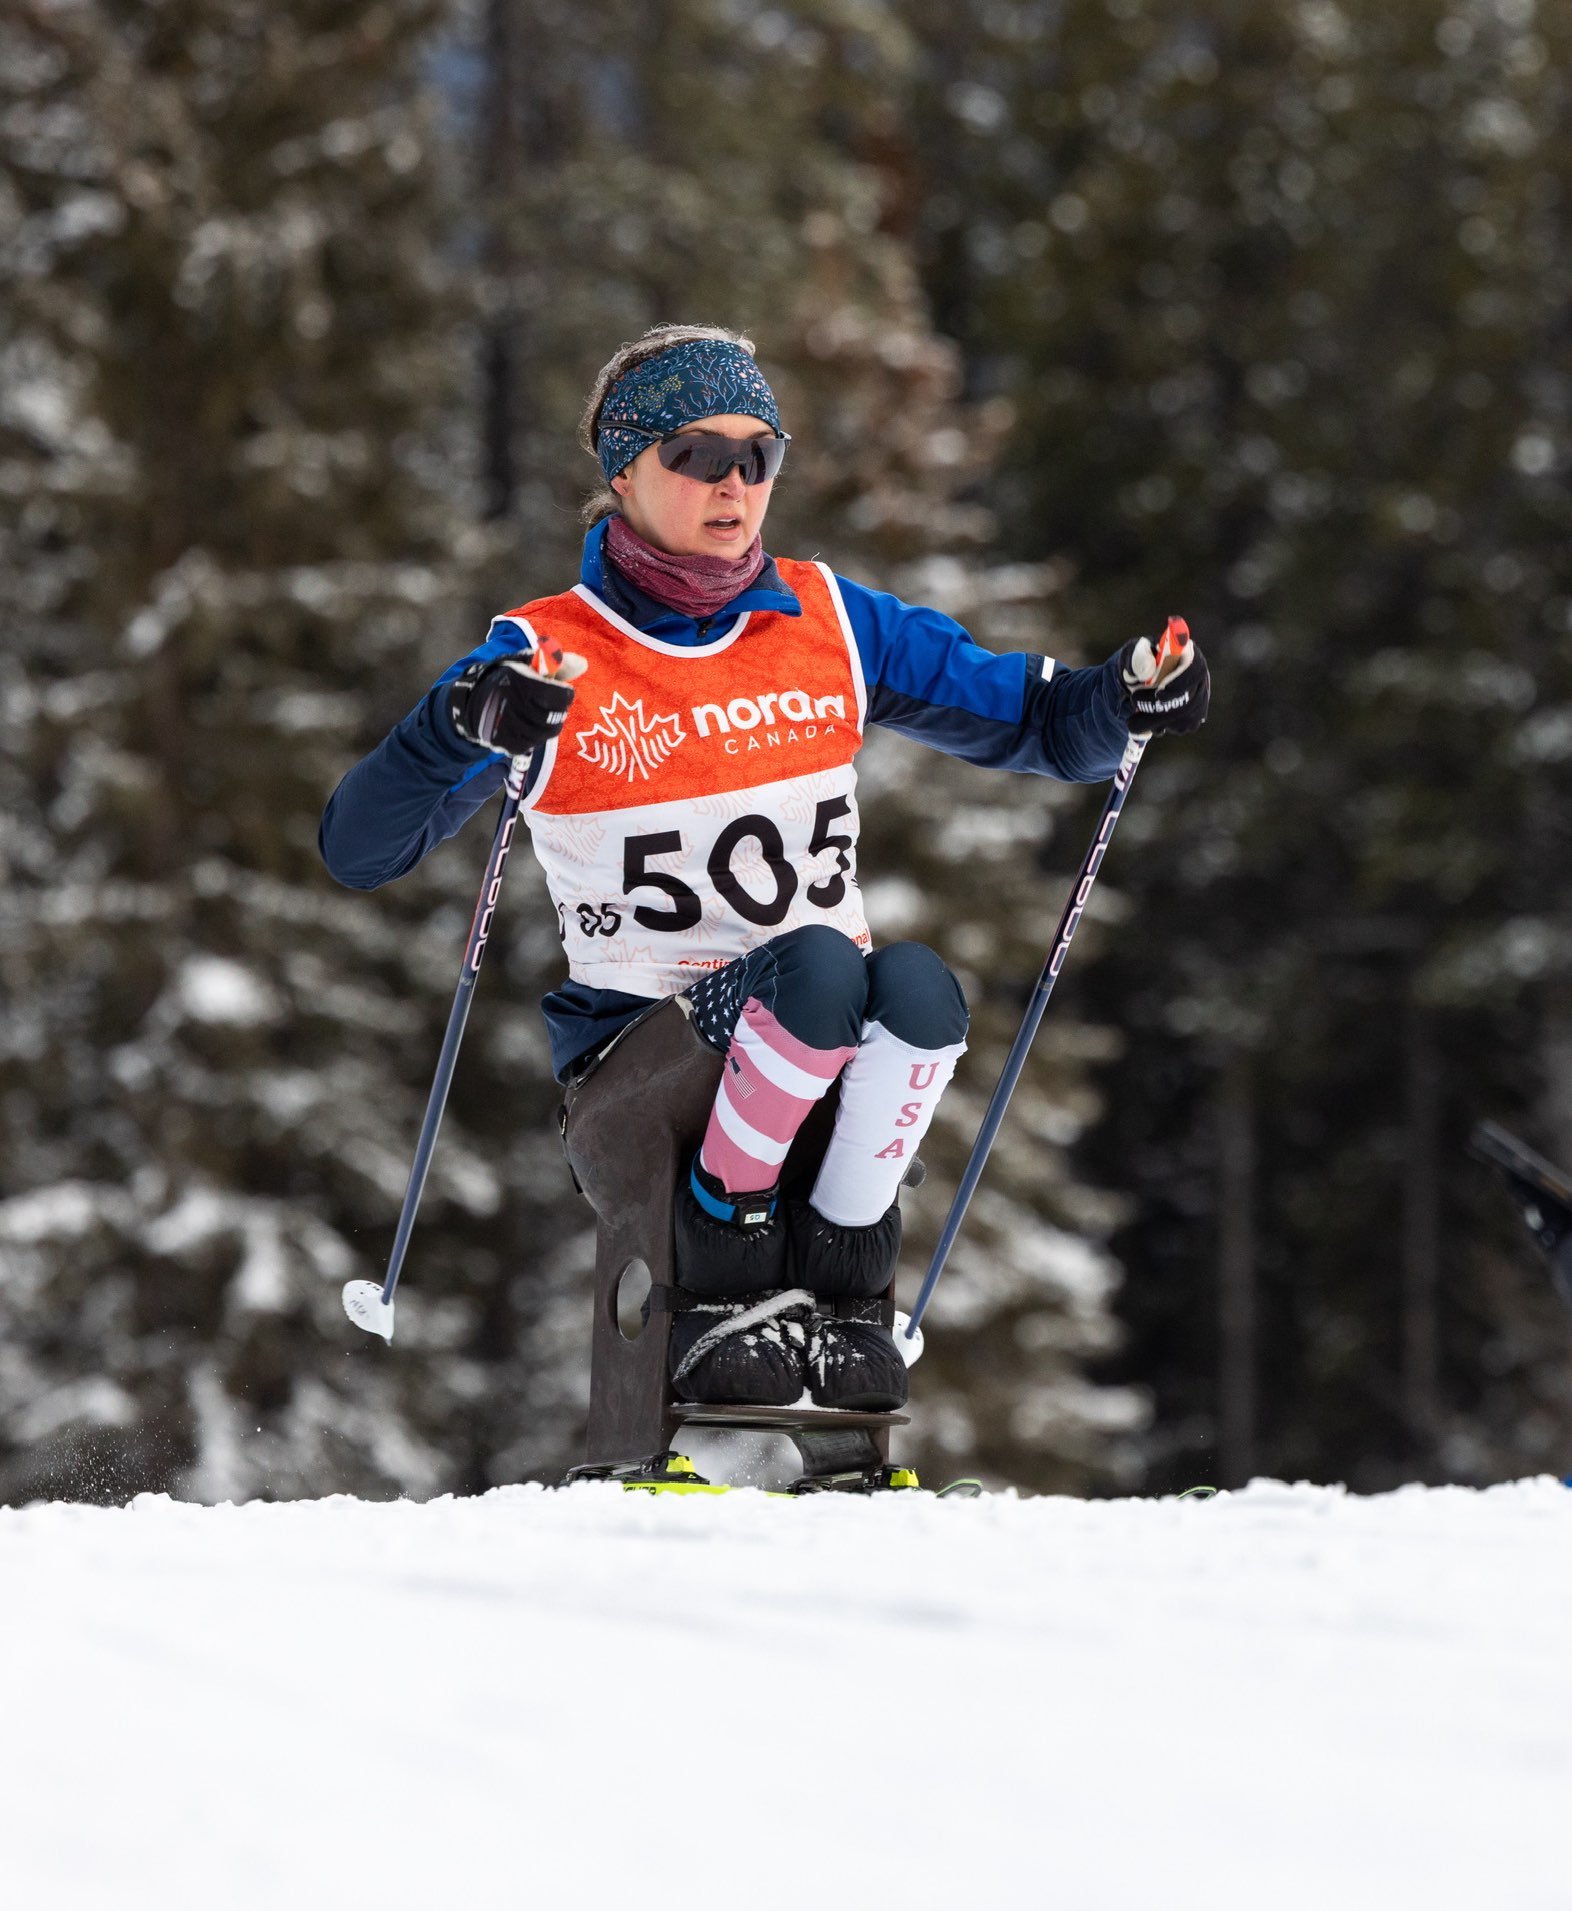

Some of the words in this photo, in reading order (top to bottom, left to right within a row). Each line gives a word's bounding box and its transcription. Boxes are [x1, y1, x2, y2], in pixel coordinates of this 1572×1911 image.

[724, 724, 836, 755] CANADA
[623, 793, 852, 932] 505
[558, 902, 622, 941] 05
